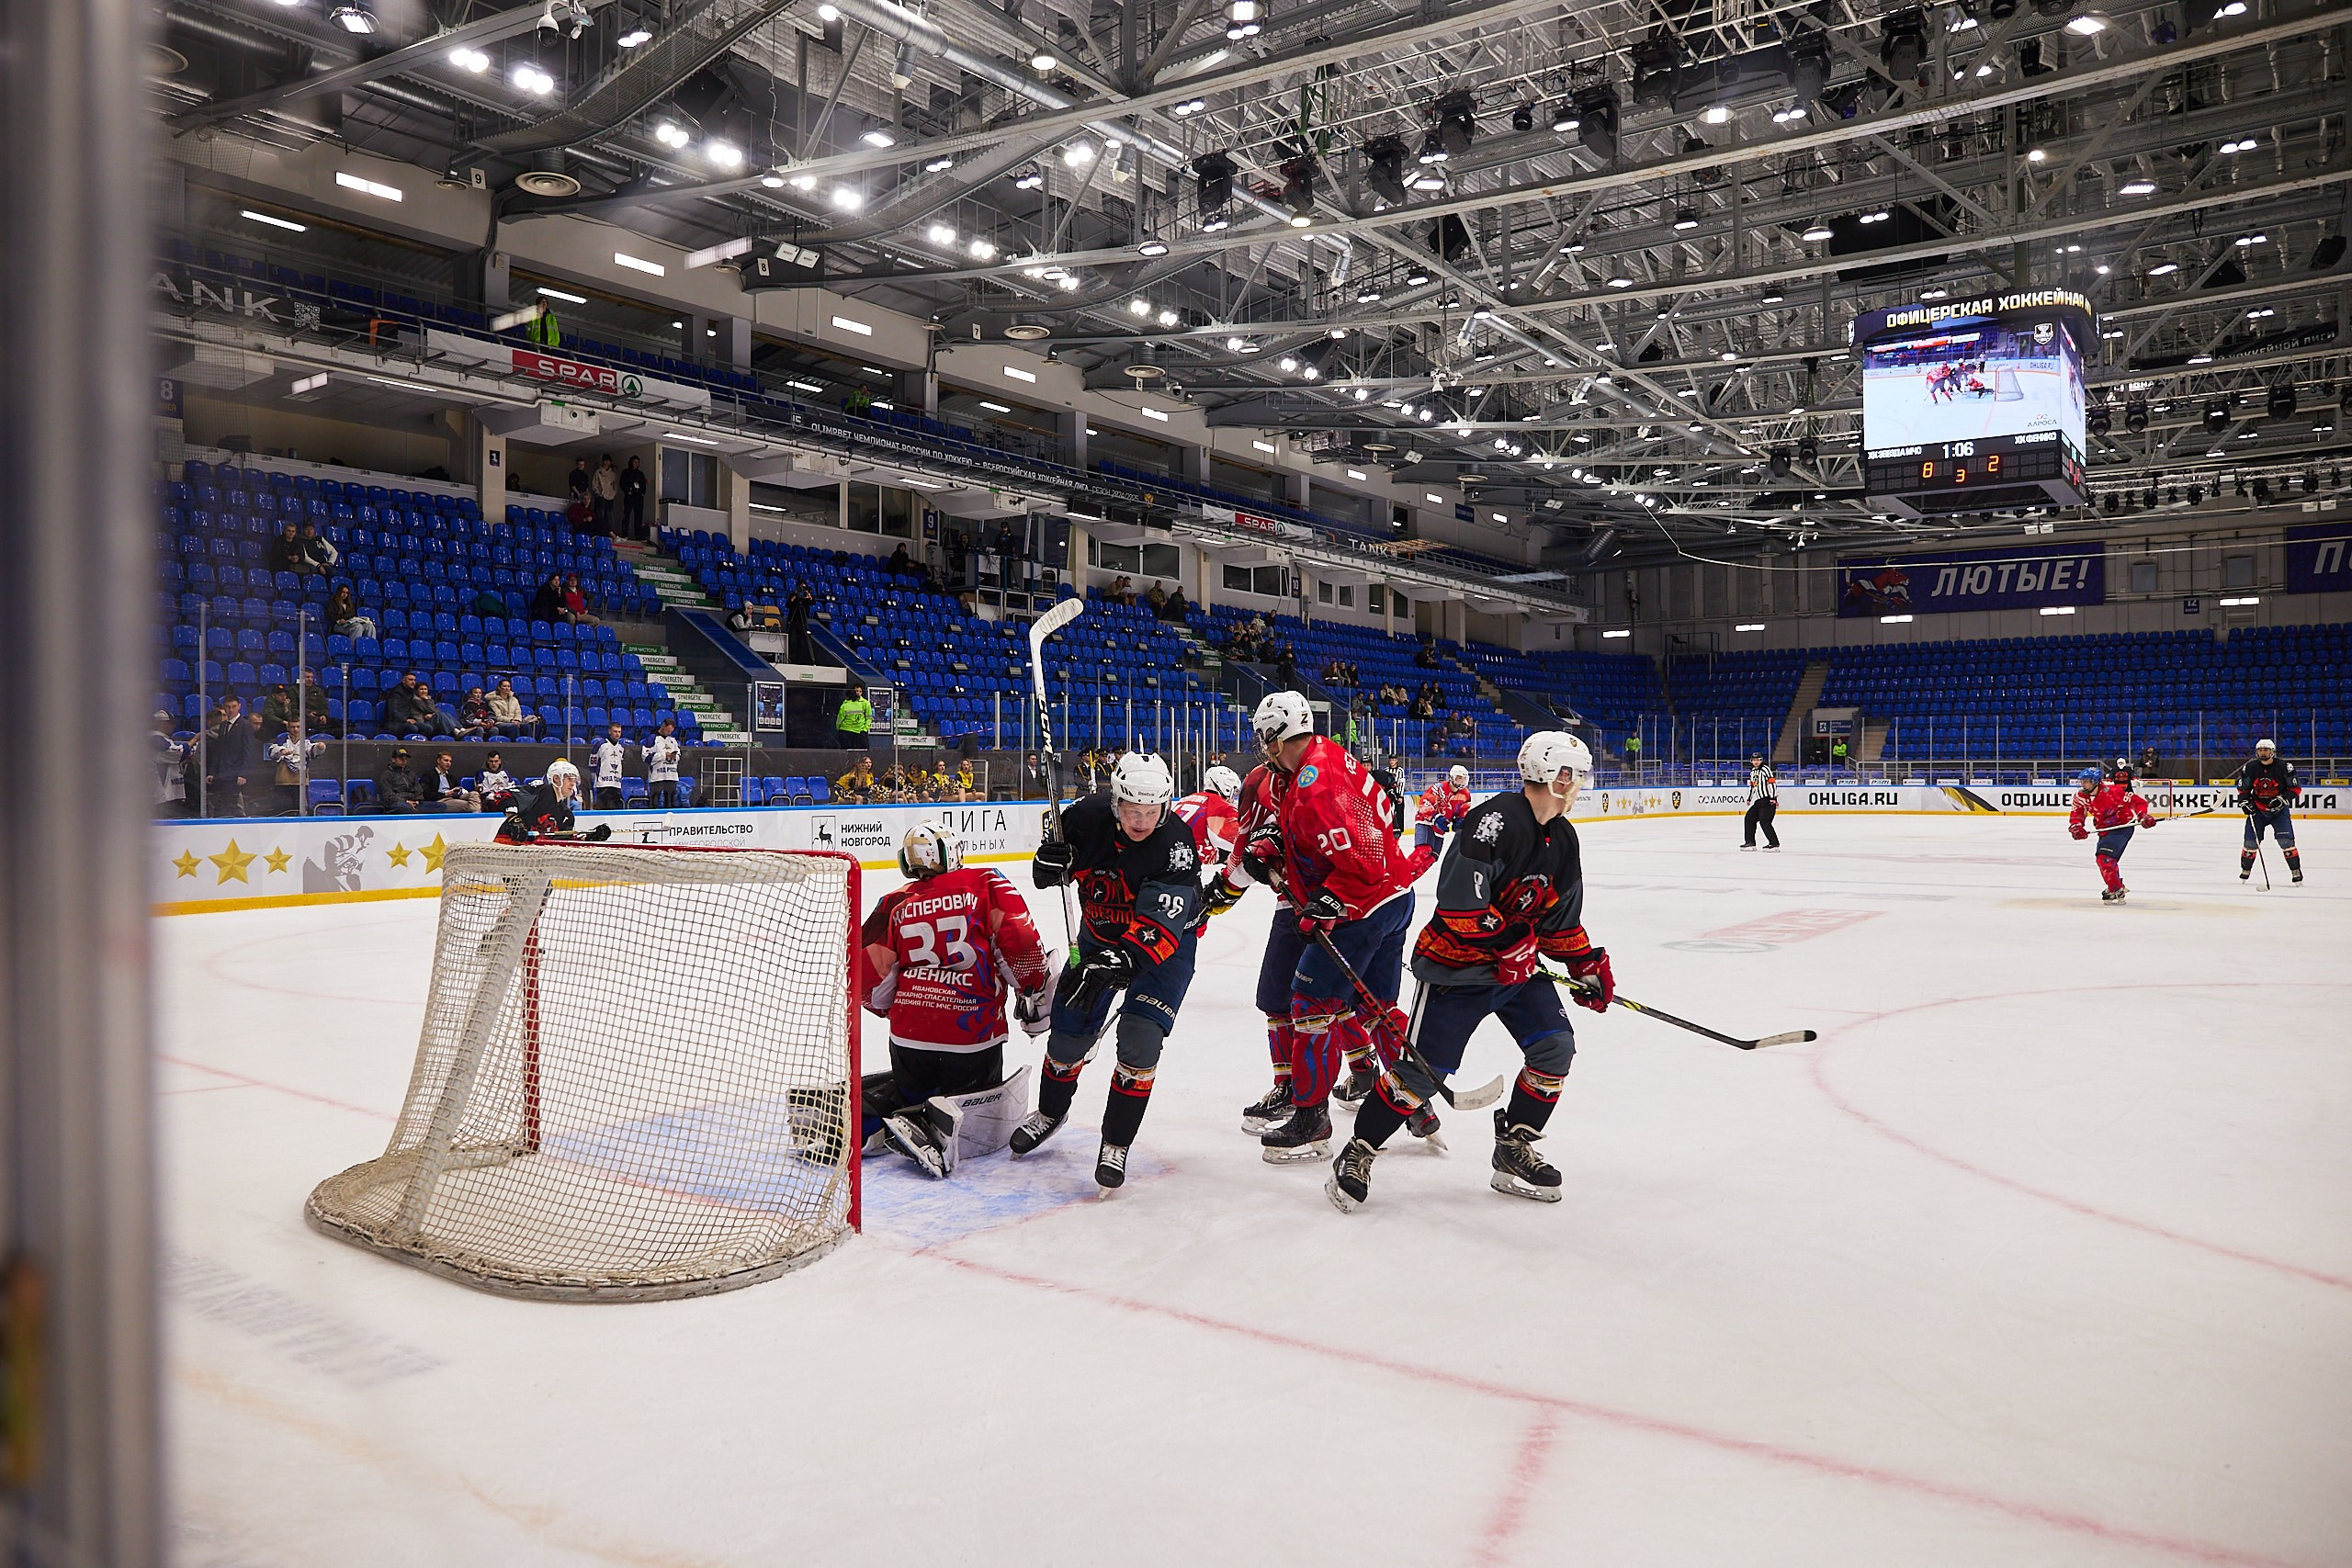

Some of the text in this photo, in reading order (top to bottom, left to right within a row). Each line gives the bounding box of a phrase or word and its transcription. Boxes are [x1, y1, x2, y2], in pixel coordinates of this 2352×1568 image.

[475, 174, 482, 185] 9
[761, 263, 767, 272] 8
[1886, 298, 1994, 328] ОФИЦЕРСКАЯ
[1997, 287, 2085, 313] ХОККЕЙНАЯ
[537, 358, 616, 392] SPAR
[160, 379, 174, 400] 8
[1942, 441, 1974, 459] 1:06
[1922, 462, 1933, 479] 8
[1987, 455, 1999, 472] 2
[1955, 469, 1966, 482] 3
[927, 514, 934, 529] 9
[1243, 516, 1276, 532] SPAR
[1347, 537, 1389, 558] TANK
[2313, 541, 2352, 574] П
[1292, 579, 1299, 591] 10
[1931, 558, 2090, 598] ЛЮТЫЕ!
[1809, 792, 1898, 806] OHLIGA.RU
[2001, 789, 2336, 809] ОФИЦЕ ХОККЕЙН ИГА
[669, 824, 753, 837] ПРАВИТЕЛЬСТВО
[841, 820, 882, 834] НИЖНИЙ
[841, 836, 891, 848] НОВГОРОД
[962, 839, 1006, 852] ЛЬНЫХ
[1317, 827, 1351, 856] 20
[899, 915, 978, 972] 33
[1582, 962, 1595, 973] CCM
[903, 967, 974, 987] ФЕНИКС
[911, 985, 956, 996] ИВАНОВСКАЯ
[936, 1002, 952, 1010] МЧС
[953, 1004, 979, 1012] РОССИИ
[961, 1092, 1003, 1108] BAUER
